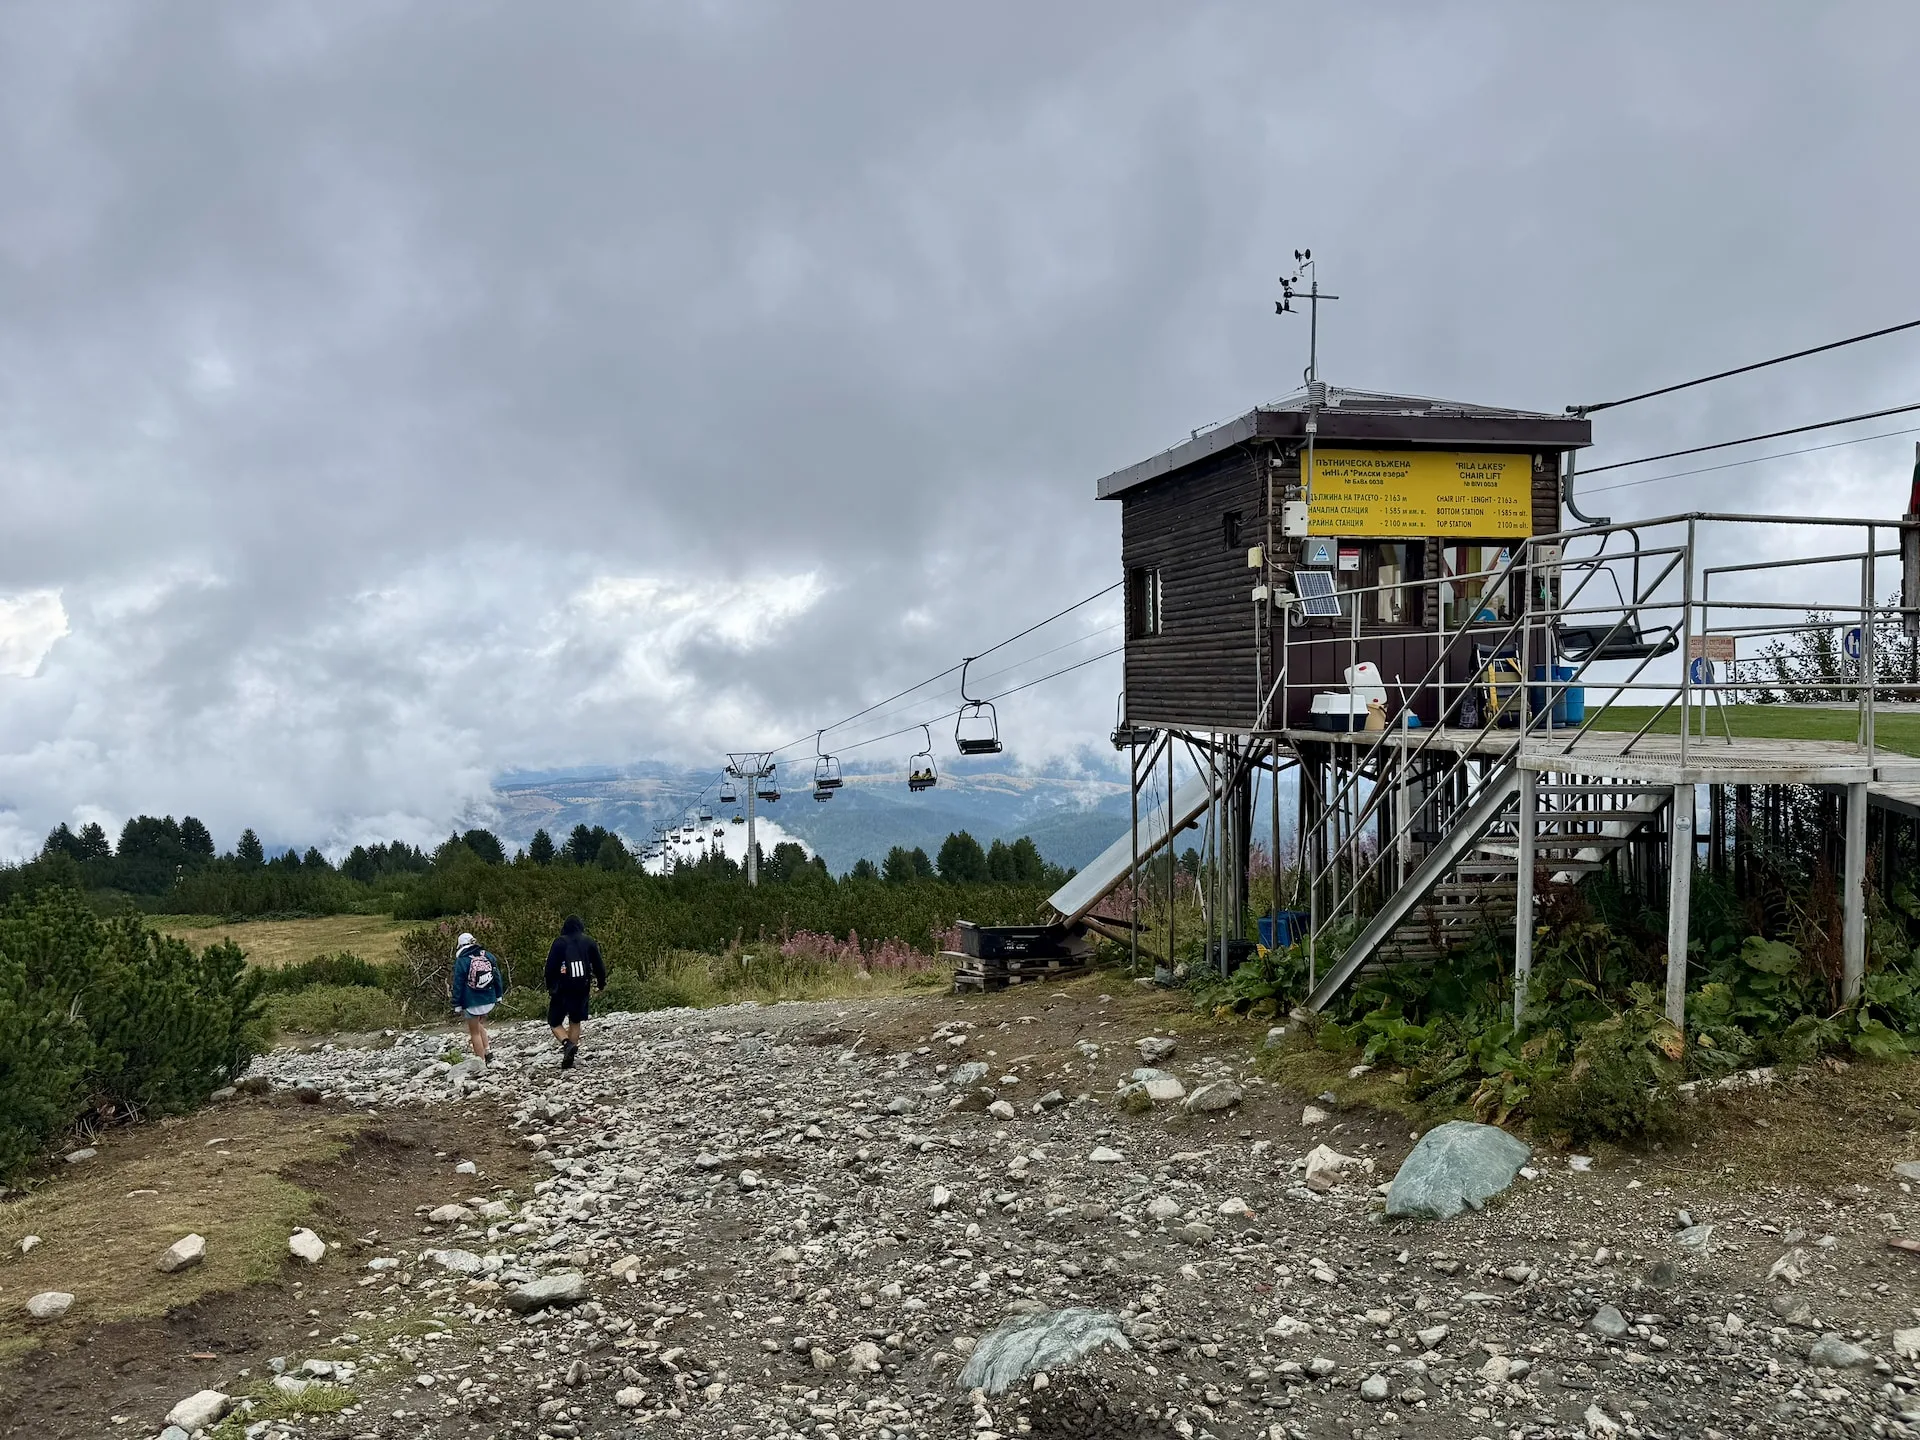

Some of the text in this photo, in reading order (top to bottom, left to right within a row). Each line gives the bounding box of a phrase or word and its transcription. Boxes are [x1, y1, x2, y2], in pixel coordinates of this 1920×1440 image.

[1316, 459, 1411, 468] ПЪТНИЧЕСКА ВЪЖЕНА
[1382, 470, 1408, 478] езера"
[1340, 506, 1368, 514] СТАНЦИЯ
